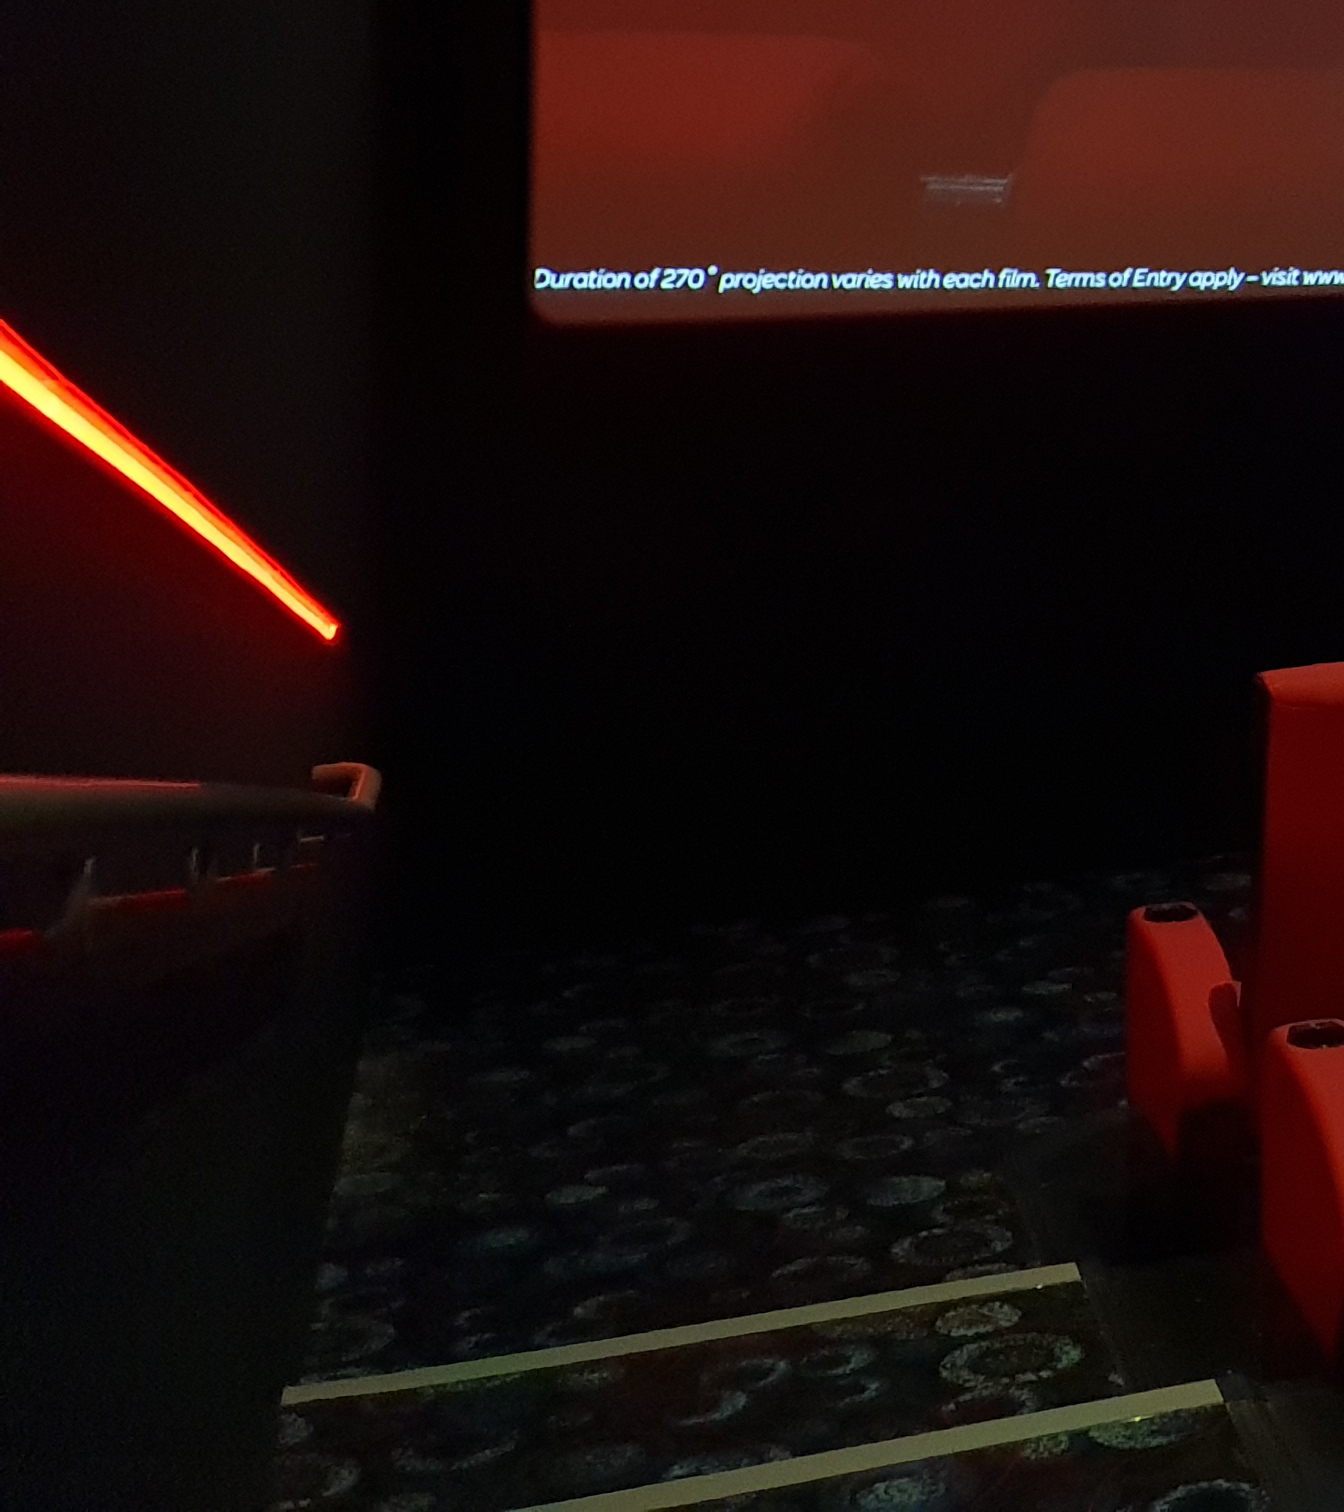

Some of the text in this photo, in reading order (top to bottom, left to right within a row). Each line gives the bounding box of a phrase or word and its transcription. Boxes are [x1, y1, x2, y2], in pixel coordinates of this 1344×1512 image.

[534, 267, 631, 290] Duration
[633, 267, 659, 289] of
[718, 268, 829, 294] projection
[832, 267, 894, 290] varies
[897, 269, 940, 290] with
[943, 268, 995, 290] each
[998, 268, 1040, 289] film.
[1046, 268, 1106, 289] Terms
[1109, 267, 1132, 288] of
[1132, 267, 1187, 291] Entry
[1188, 266, 1245, 291] apply
[1260, 266, 1299, 287] visit
